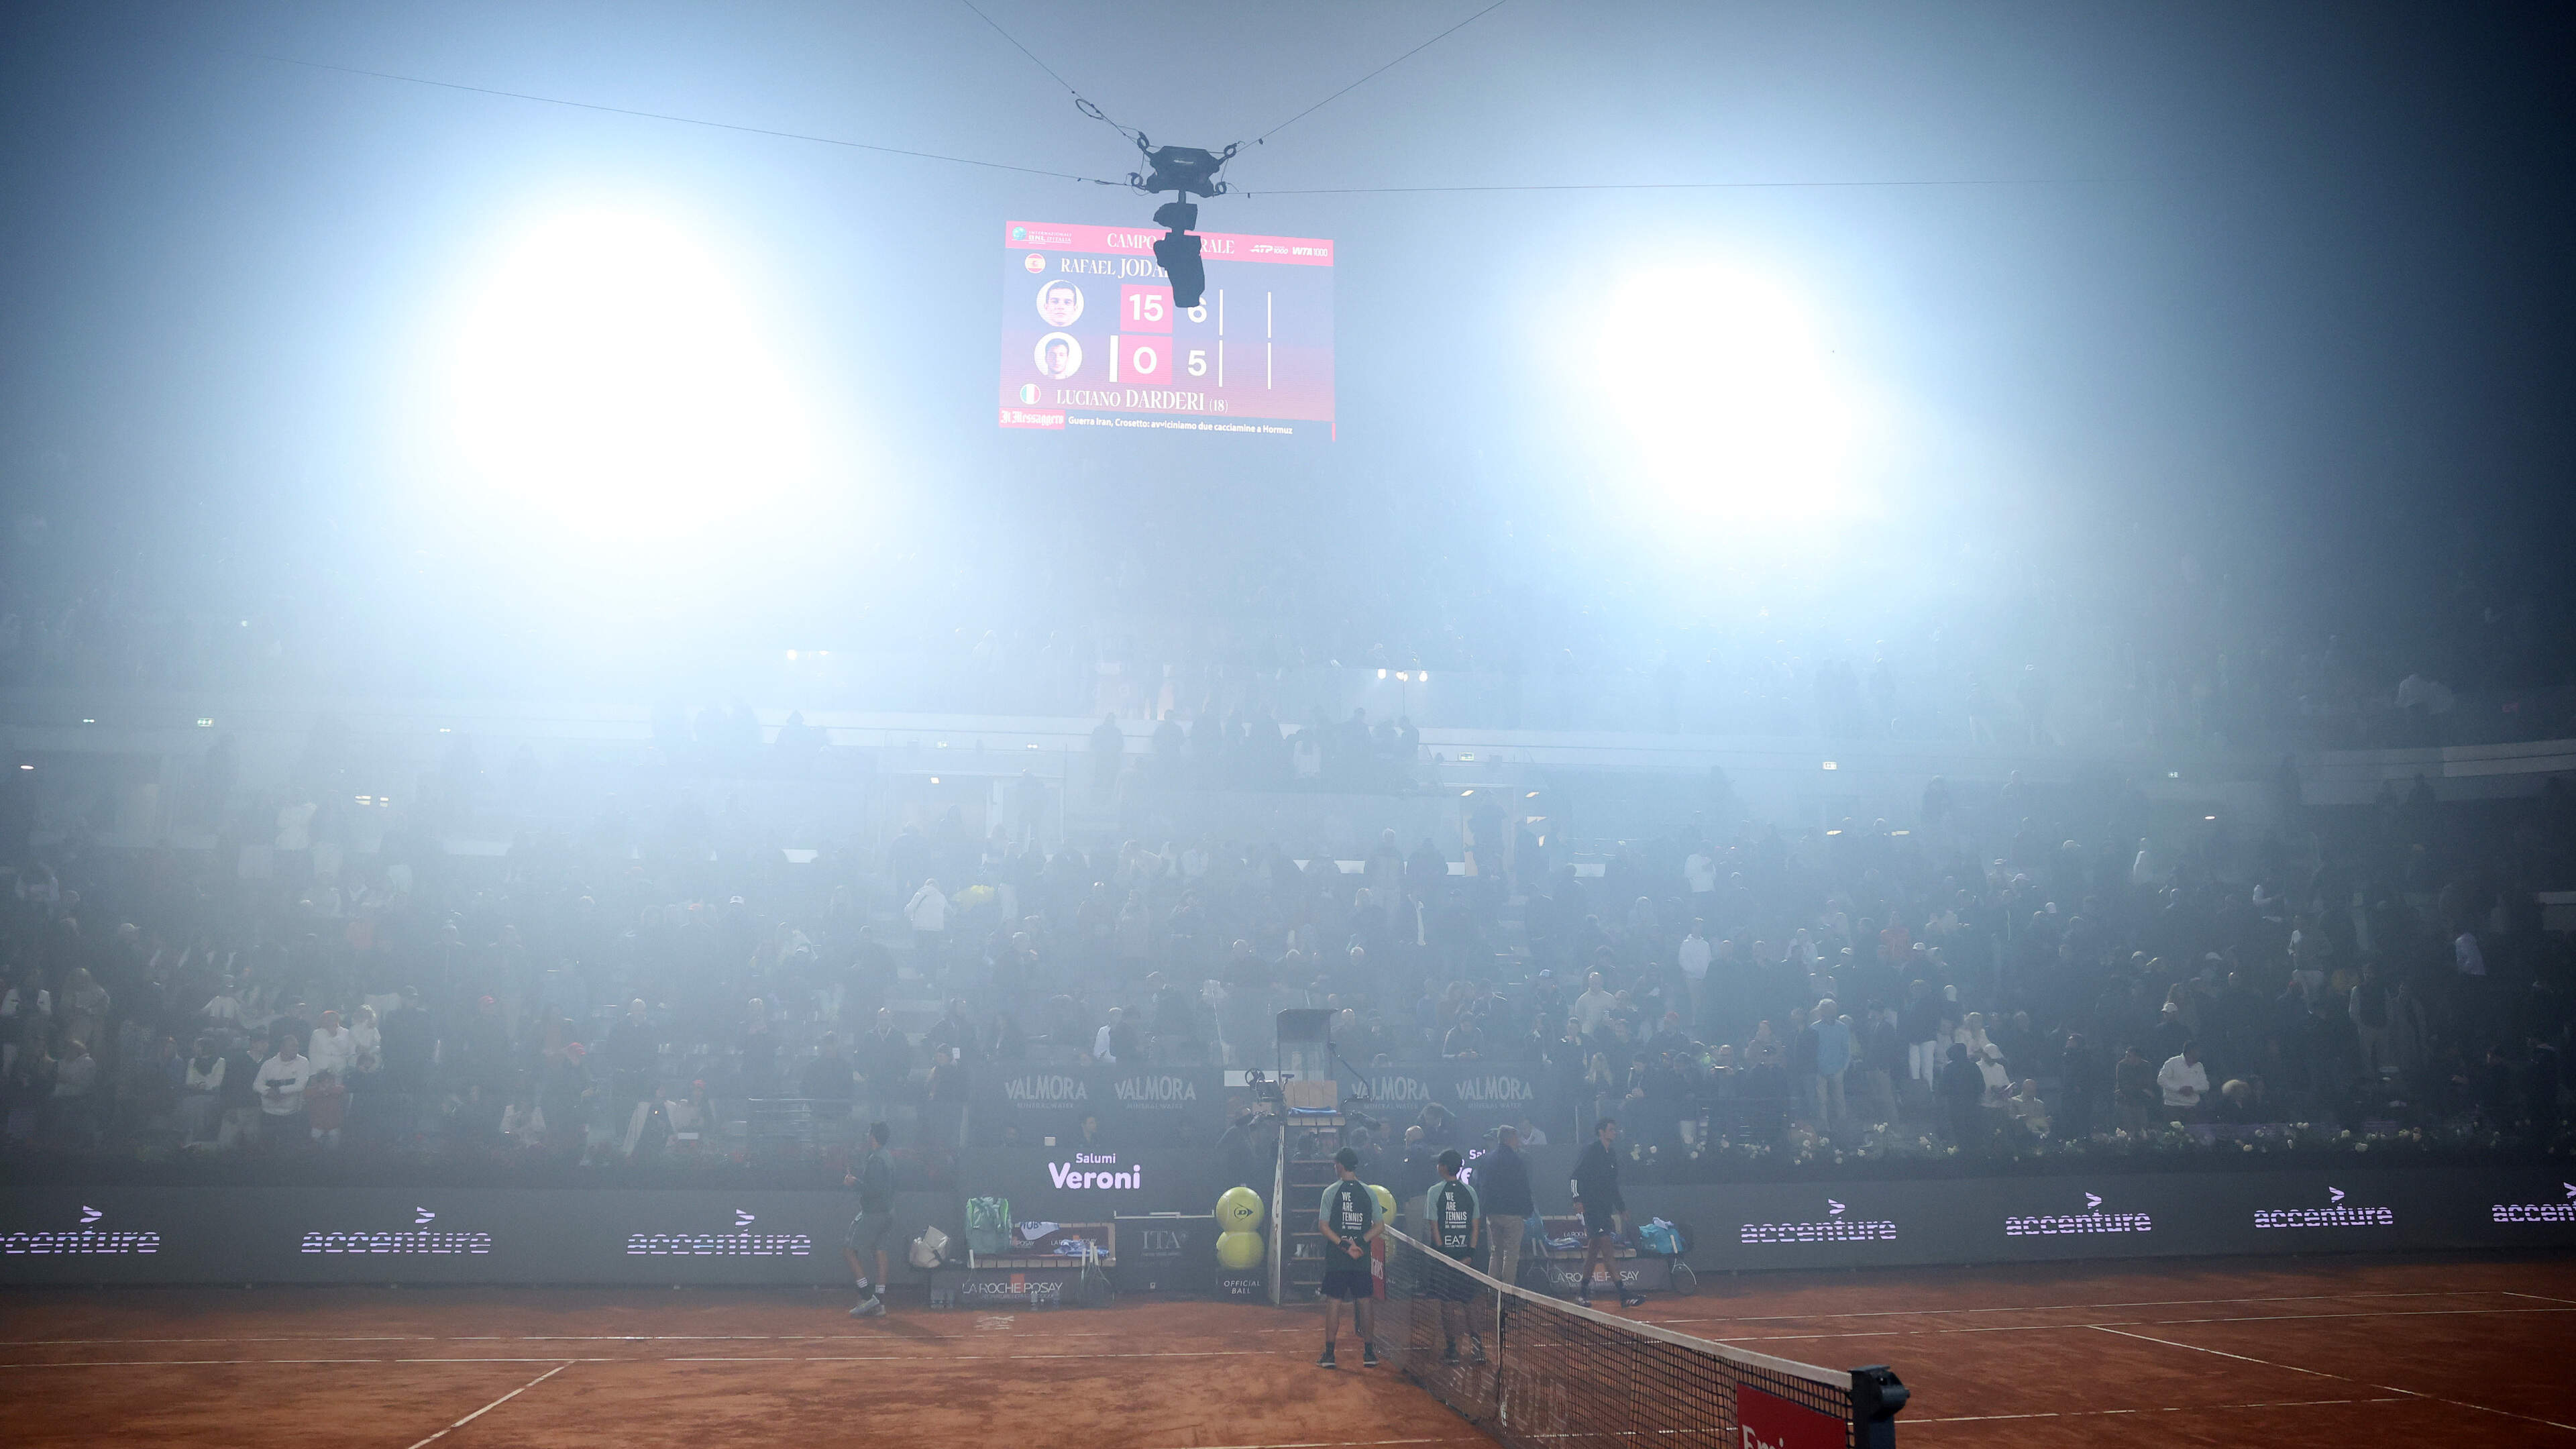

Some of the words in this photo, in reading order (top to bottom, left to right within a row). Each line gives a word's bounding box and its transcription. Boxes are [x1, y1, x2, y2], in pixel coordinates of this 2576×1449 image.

[1107, 233, 1157, 249] CAMPO
[1250, 244, 1273, 254] ATP
[1292, 246, 1313, 256] WTA
[1313, 248, 1328, 257] 1000
[1061, 257, 1116, 276] RAFAEL
[1129, 294, 1163, 321] 15
[1187, 297, 1208, 323] 6
[1133, 347, 1157, 374] 0
[1188, 350, 1207, 376] 5
[1057, 389, 1121, 407] LUCIANO
[1125, 389, 1205, 411] DARDERI
[1209, 399, 1229, 414] (18)
[1068, 416, 1095, 425] Guerra
[1115, 419, 1150, 428] Crosetto:
[1197, 423, 1214, 431] due
[1214, 424, 1255, 433] cacciamine
[1263, 425, 1293, 435] Hormuz
[1006, 1075, 1088, 1100] VALMORA
[1114, 1075, 1197, 1101] VALMORA
[1350, 1076, 1430, 1101] VALMORA
[1454, 1075, 1534, 1101] VALMORA
[1075, 1153, 1116, 1164] Salumi
[1048, 1162, 1140, 1189] Veroni
[1342, 1192, 1351, 1201] WE
[1445, 1192, 1454, 1201] WE
[1342, 1202, 1353, 1212] ARE
[1446, 1202, 1456, 1212] ARE
[1446, 1212, 1467, 1221] TENNIS
[2254, 1204, 2394, 1228] accenture
[1342, 1212, 1363, 1222] TENNIS
[2006, 1210, 2152, 1236] accenture
[1142, 1230, 1181, 1249] ITA
[1741, 1217, 1897, 1243] accenture
[0, 1227, 160, 1254] centure
[301, 1227, 491, 1254] accenture
[627, 1230, 811, 1256] accenture
[1444, 1235, 1466, 1246] EA7
[962, 1283, 977, 1294] LA
[979, 1283, 1021, 1294] ROCHE
[1023, 1282, 1063, 1294] POSAY
